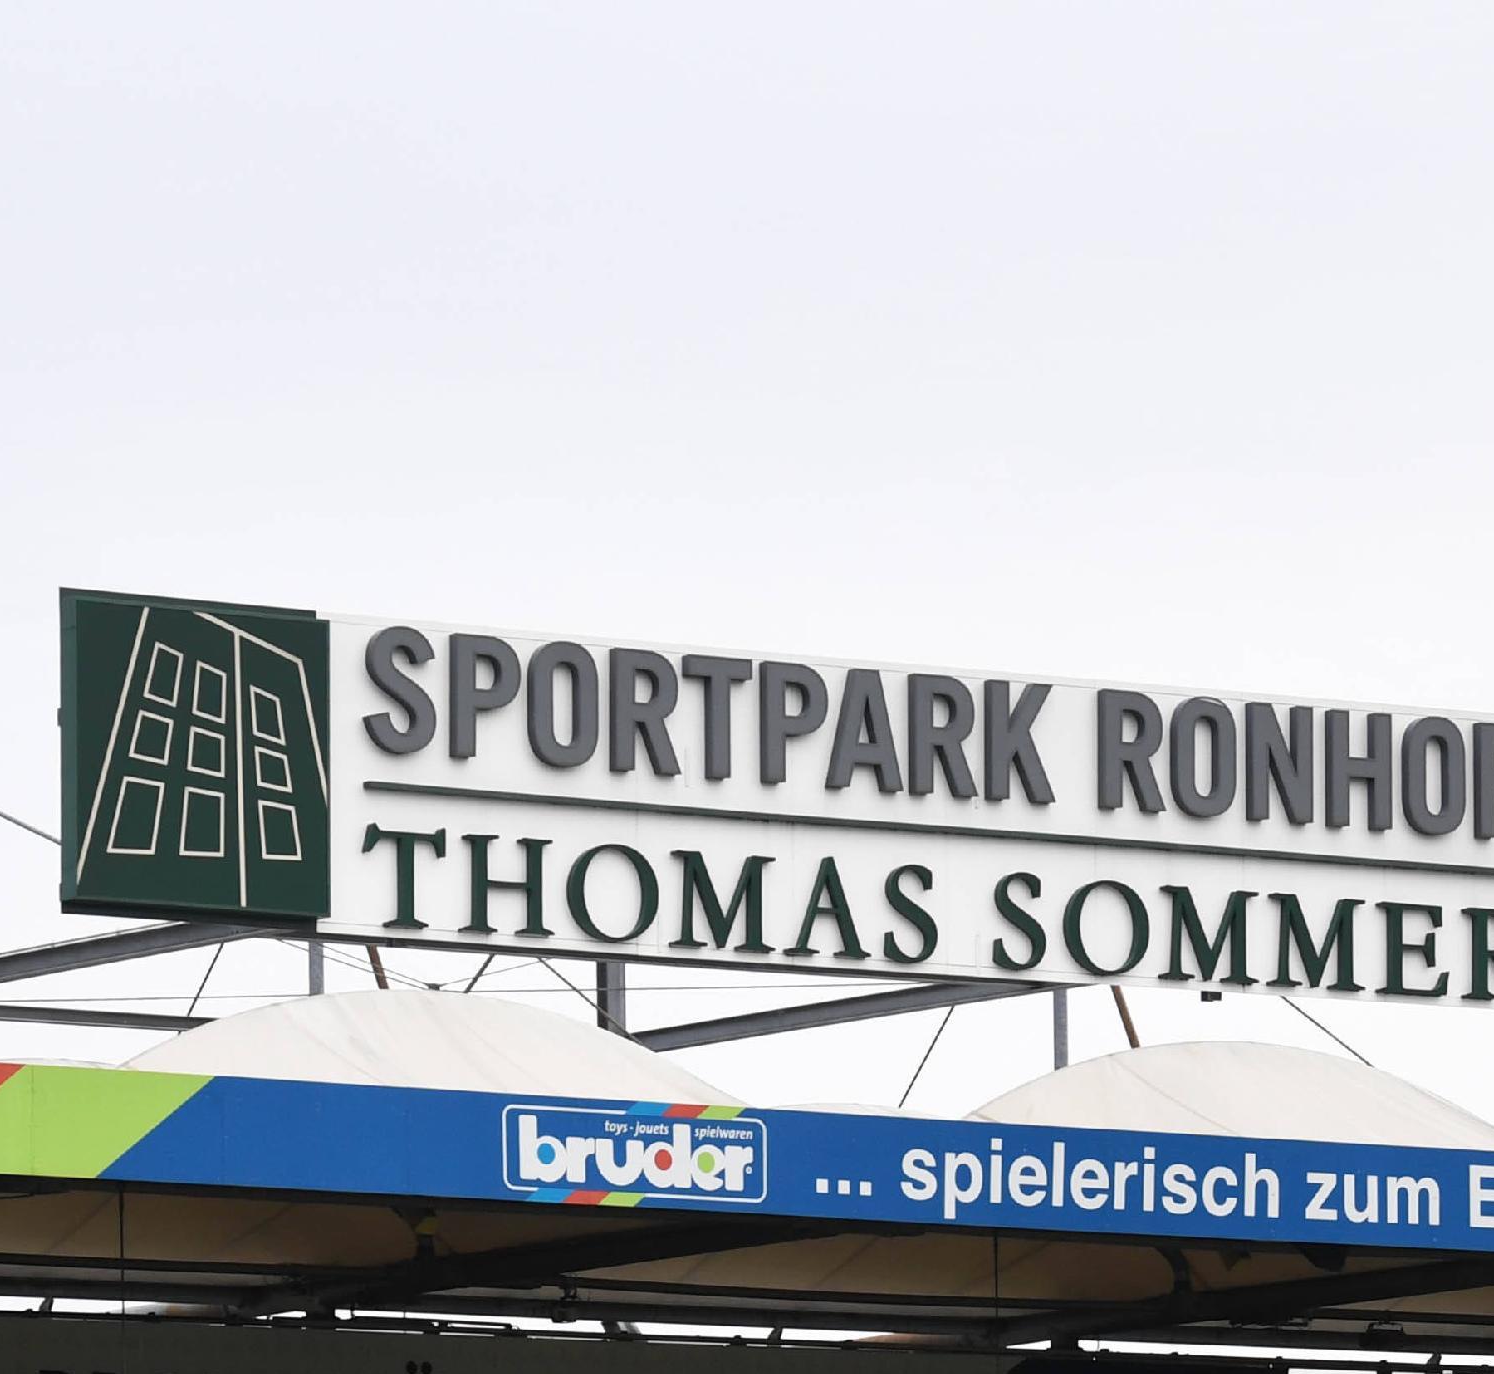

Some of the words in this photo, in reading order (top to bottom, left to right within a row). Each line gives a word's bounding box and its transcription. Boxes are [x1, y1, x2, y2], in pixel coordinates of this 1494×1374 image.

[363, 625, 1055, 802] SPORTPARK
[362, 822, 939, 964] THOMAS
[518, 1114, 754, 1192] bruder
[694, 1126, 754, 1141] spielwaren
[900, 1139, 1282, 1221] spielerisch
[1305, 1170, 1445, 1228] zum
